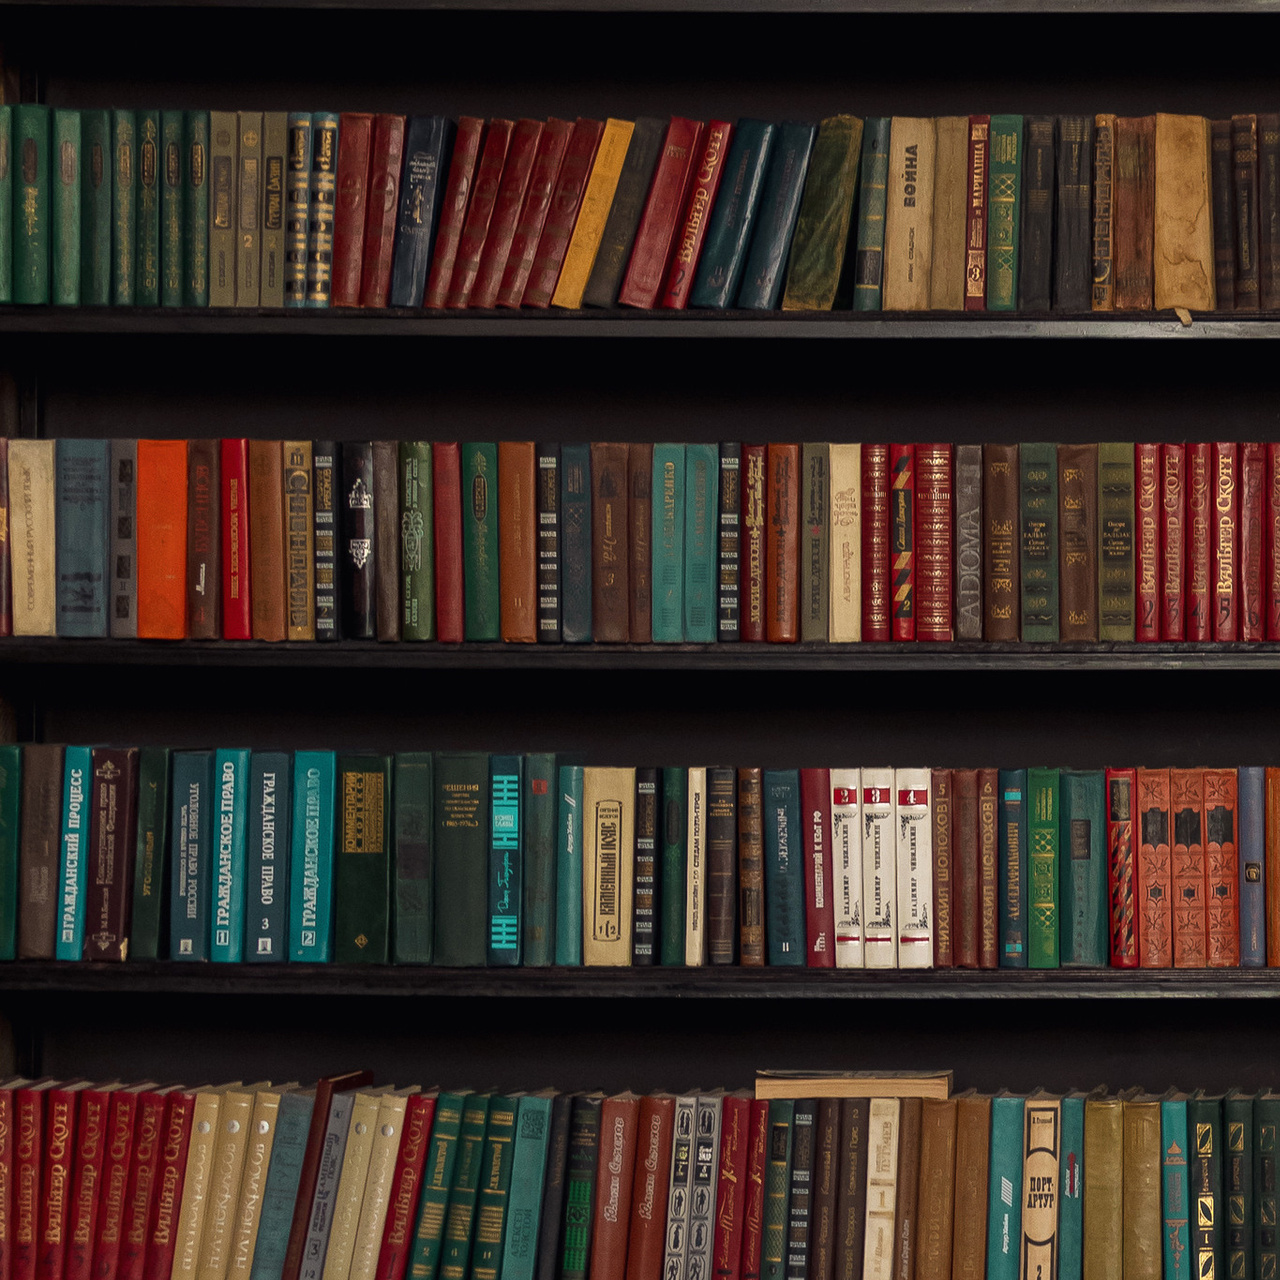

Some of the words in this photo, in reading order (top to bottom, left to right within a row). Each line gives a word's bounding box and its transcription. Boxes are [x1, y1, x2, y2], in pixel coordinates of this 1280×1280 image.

[677, 187, 710, 263] ВАЛЬТЕР
[698, 127, 725, 184] СКОТТ
[902, 144, 919, 208] ВОЙНА
[1217, 455, 1233, 512] СКОТТ
[1217, 516, 1234, 594] ВАЛЬТЕР
[68, 768, 82, 829] ПРОЦЕСС
[221, 762, 236, 812] ПРАВО
[260, 772, 276, 861] ГРАЖДАНСКОЕ
[345, 772, 355, 852] КОММЕНТАРИЙ
[599, 822, 616, 851] ПОЯС
[936, 803, 950, 881] ШОЛОХОВ
[64, 832, 80, 929] ГРАЖДАНСКИЙ
[215, 813, 234, 926] ГРАЖДАНСКОЕ
[260, 865, 274, 905] ПРАВО
[598, 853, 616, 916] КАМЕННЫЙ
[937, 884, 951, 953] МИХАИЛ
[1028, 1191, 1055, 1209] АРТУР
[1036, 1265, 1042, 1280] 2
